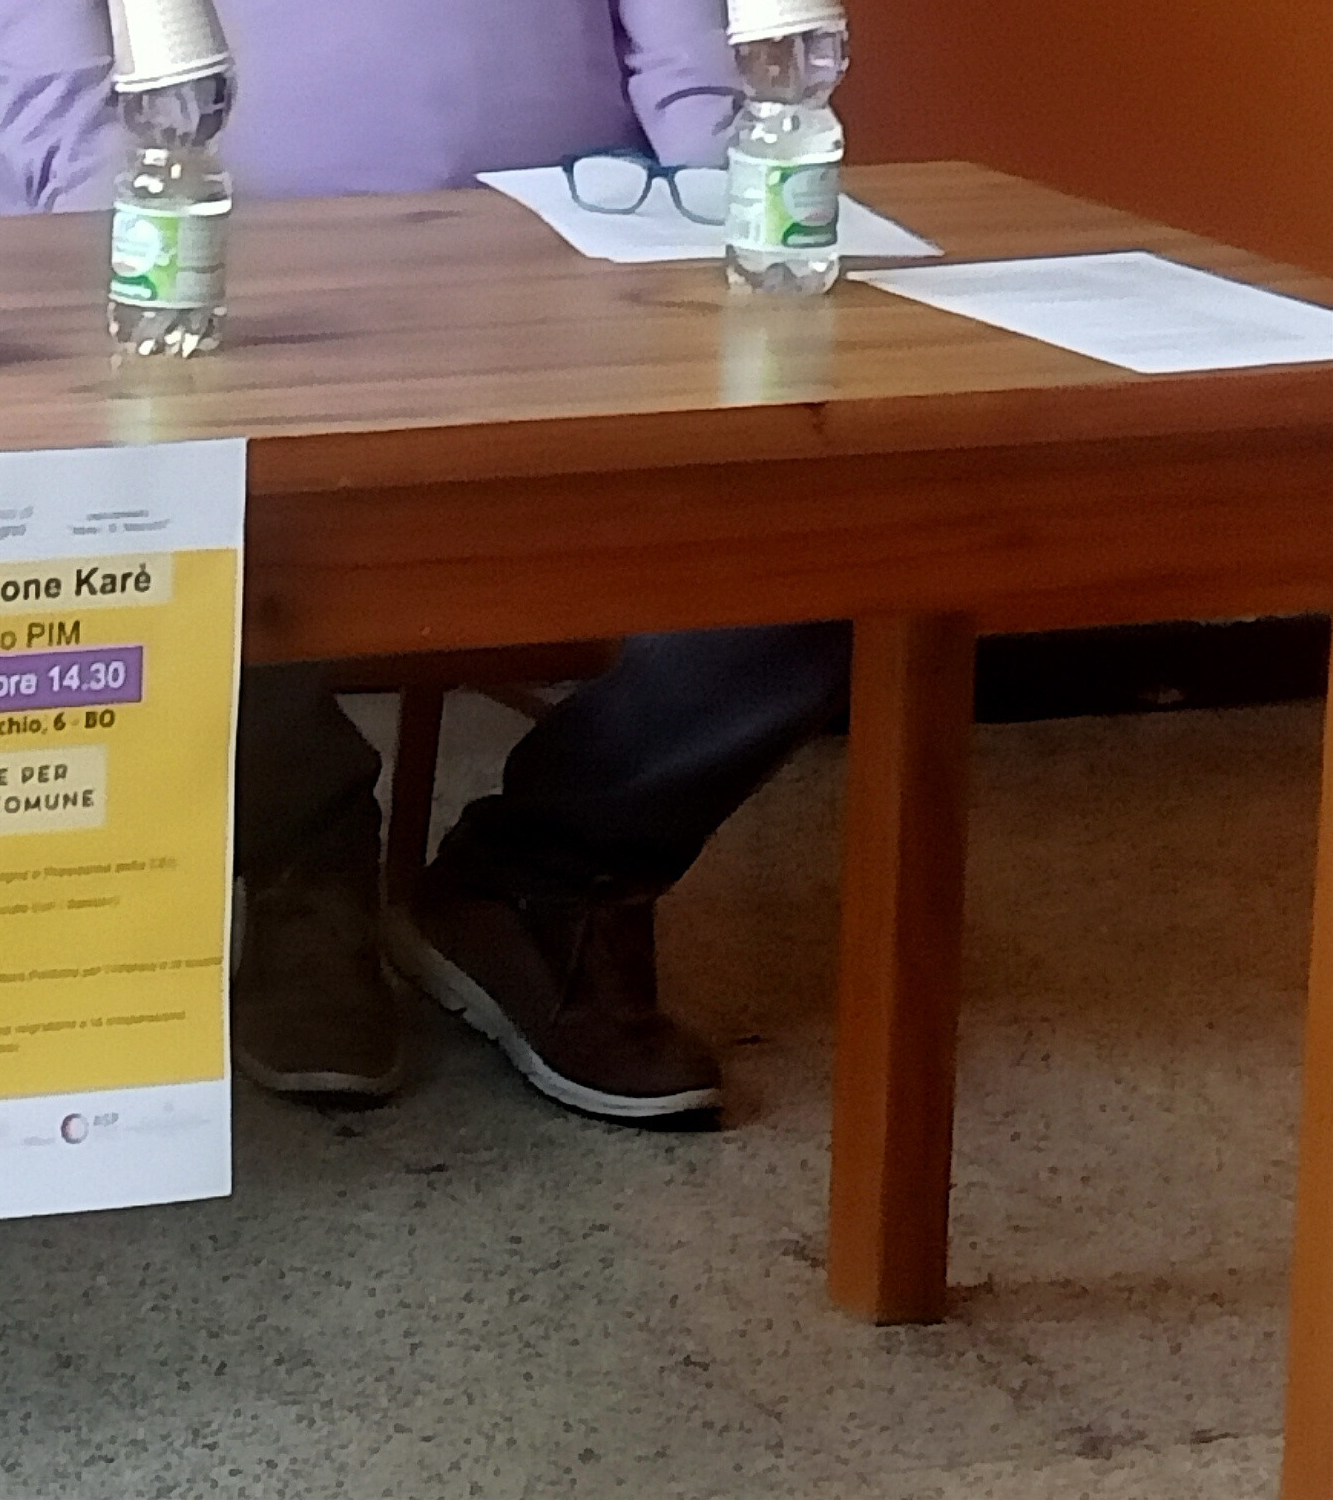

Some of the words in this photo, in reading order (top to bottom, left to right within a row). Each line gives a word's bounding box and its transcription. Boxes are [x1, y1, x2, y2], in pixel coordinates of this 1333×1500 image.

[26, 620, 82, 648] PIM
[46, 660, 127, 692] 14.30
[52, 712, 67, 733] 6
[83, 708, 116, 731] BO
[21, 763, 69, 785] PER
